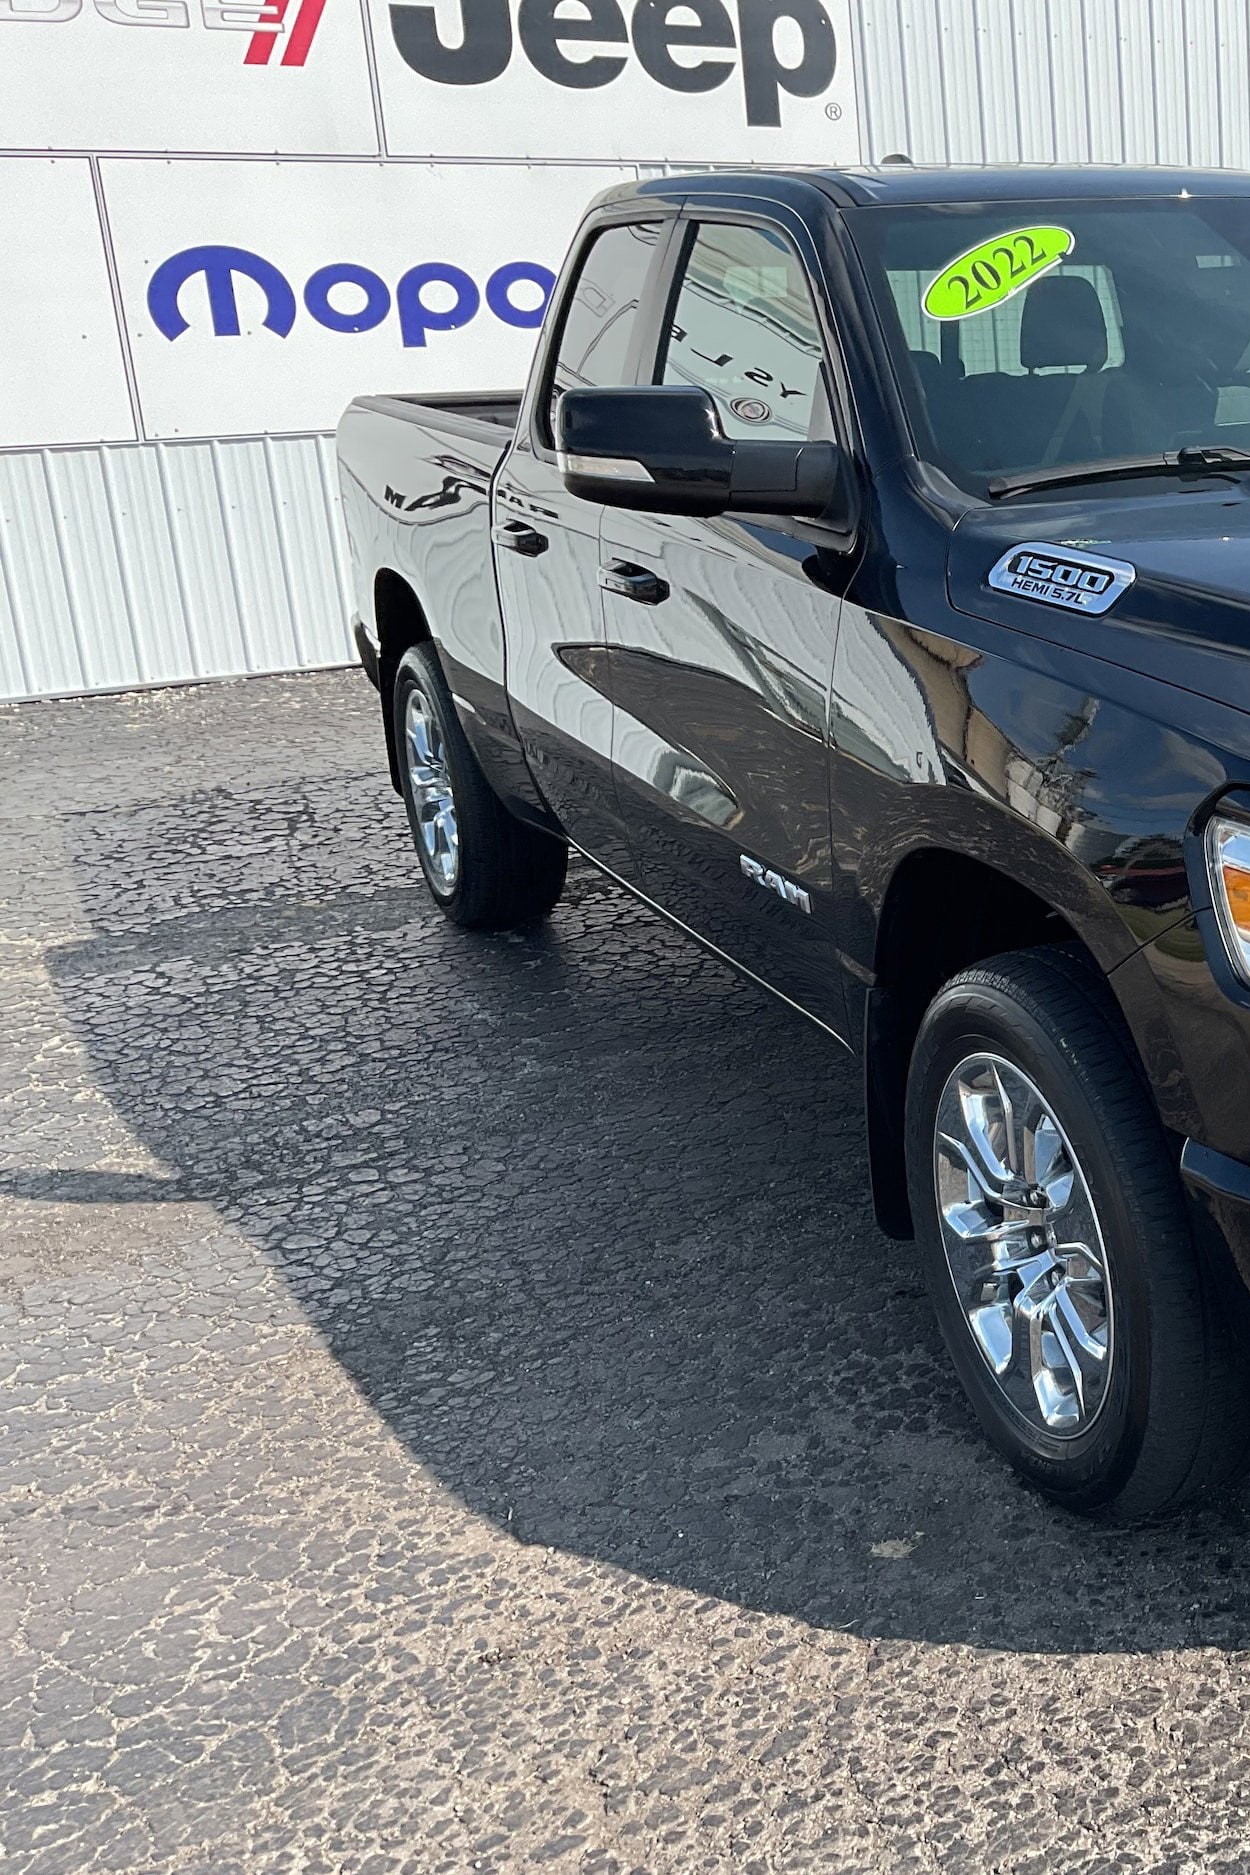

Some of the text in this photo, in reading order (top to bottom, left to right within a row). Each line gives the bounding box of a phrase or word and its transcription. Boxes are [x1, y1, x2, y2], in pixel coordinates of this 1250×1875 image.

[388, 0, 838, 128] Jeep
[947, 235, 1047, 310] 2022
[1011, 577, 1084, 606] HEMI 5.7L
[1016, 555, 1111, 593] 1500
[739, 853, 812, 915] RAM
